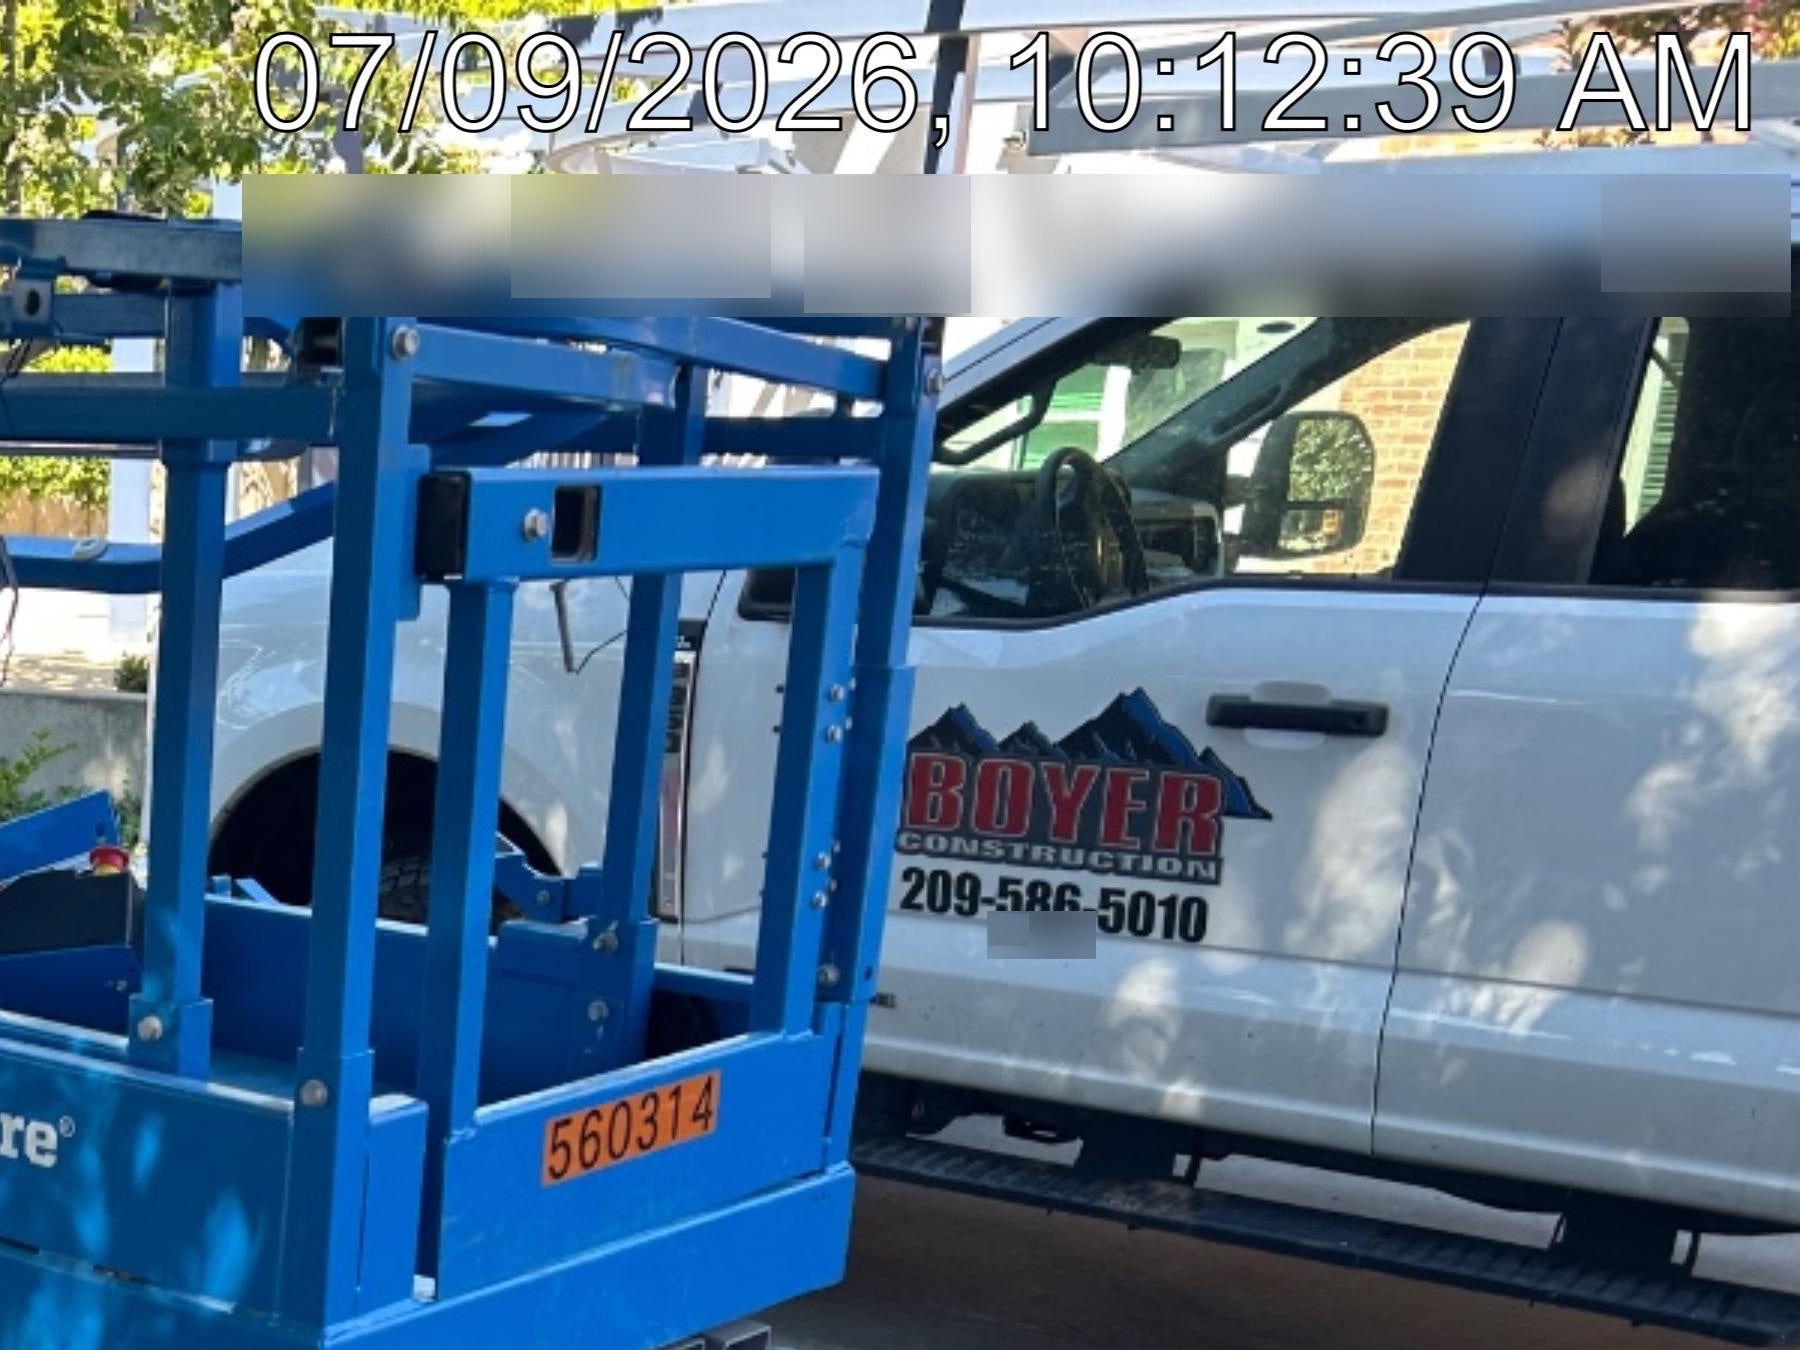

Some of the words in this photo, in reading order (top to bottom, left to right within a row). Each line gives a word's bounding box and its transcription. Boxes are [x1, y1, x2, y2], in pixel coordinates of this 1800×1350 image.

[905, 752, 1223, 856] BOYER
[898, 831, 1218, 881] CONSTRUCTION
[899, 866, 1208, 943] 209-586-5010
[547, 1075, 715, 1181] 560314
